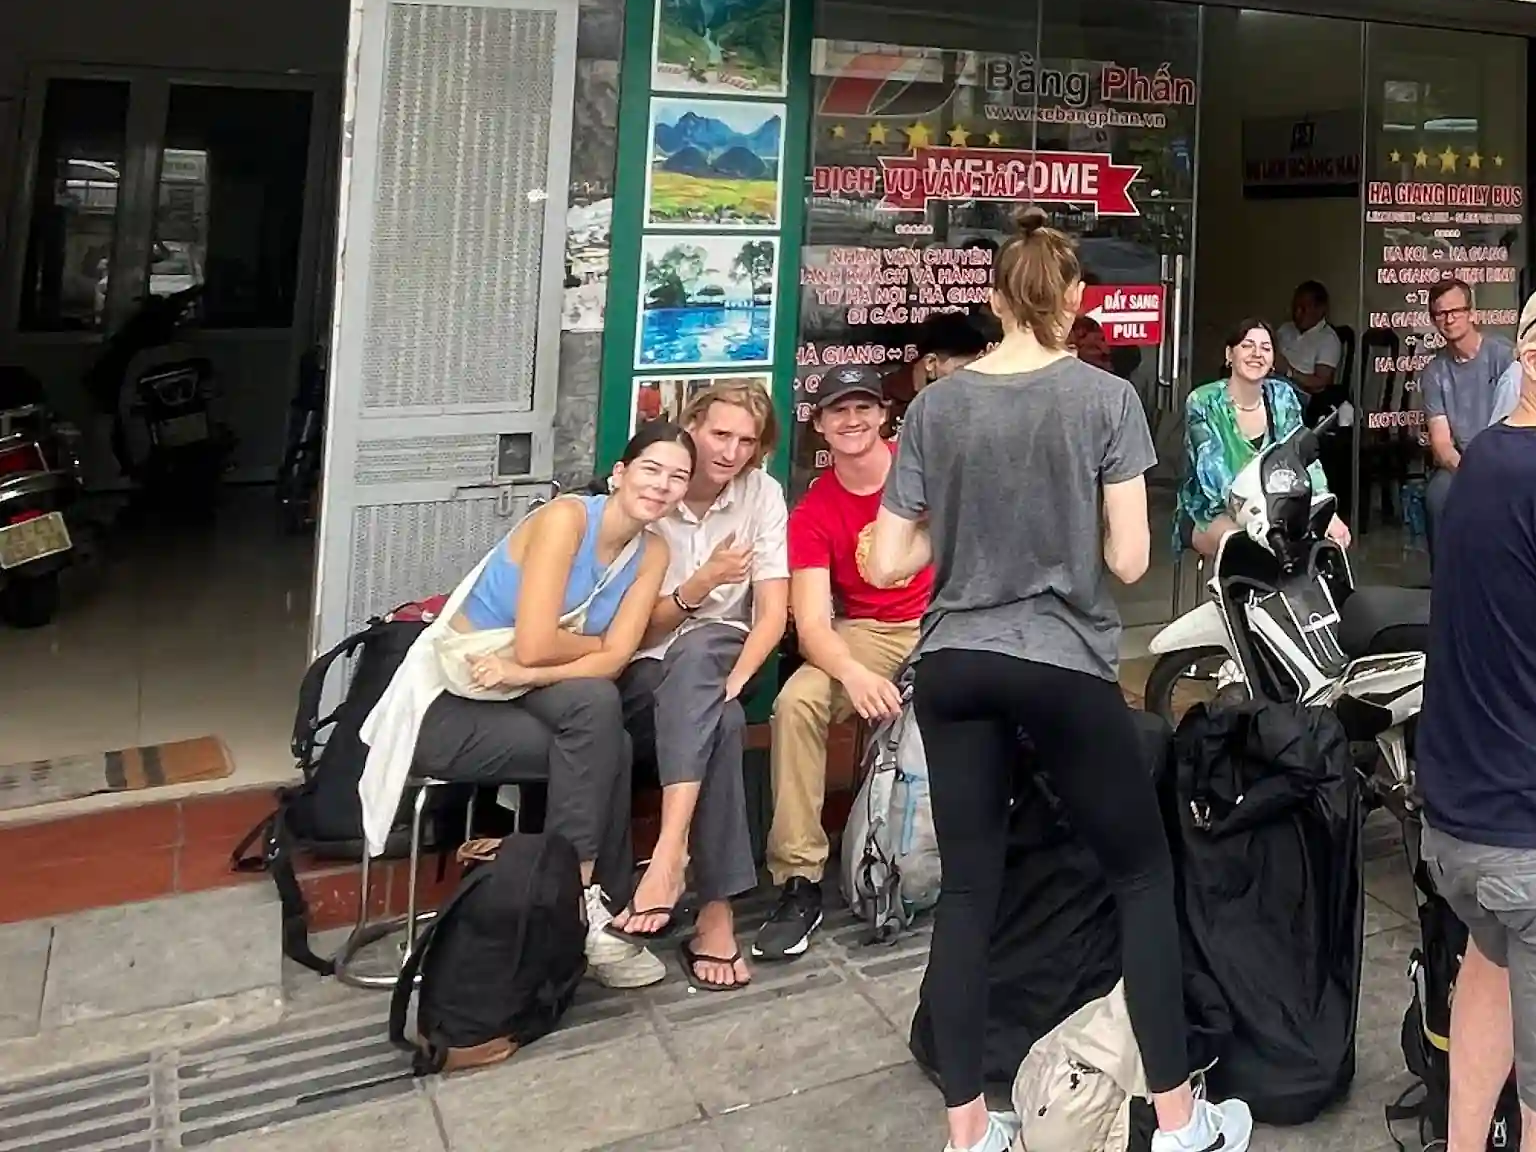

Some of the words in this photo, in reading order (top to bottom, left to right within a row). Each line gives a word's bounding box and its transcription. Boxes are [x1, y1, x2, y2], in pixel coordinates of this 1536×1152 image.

[984, 50, 1090, 108] Bằng
[1100, 61, 1197, 106] Phấn
[984, 104, 1166, 128] wwwxebangphan.vn
[811, 164, 877, 199] DỊCH
[884, 166, 917, 200] VỤ
[927, 157, 1099, 197] WELCOME
[1368, 181, 1392, 204] HA
[1395, 182, 1444, 205] GIANG
[1448, 183, 1490, 206] DAILY
[1492, 185, 1522, 206] BUS
[846, 283, 873, 305] HÀ
[875, 286, 907, 306] NỘI
[919, 283, 944, 304] HÀ
[1129, 294, 1159, 309] SANG
[870, 304, 908, 324] CÁC
[1113, 323, 1148, 339] PULL
[822, 345, 885, 365] GIANG
